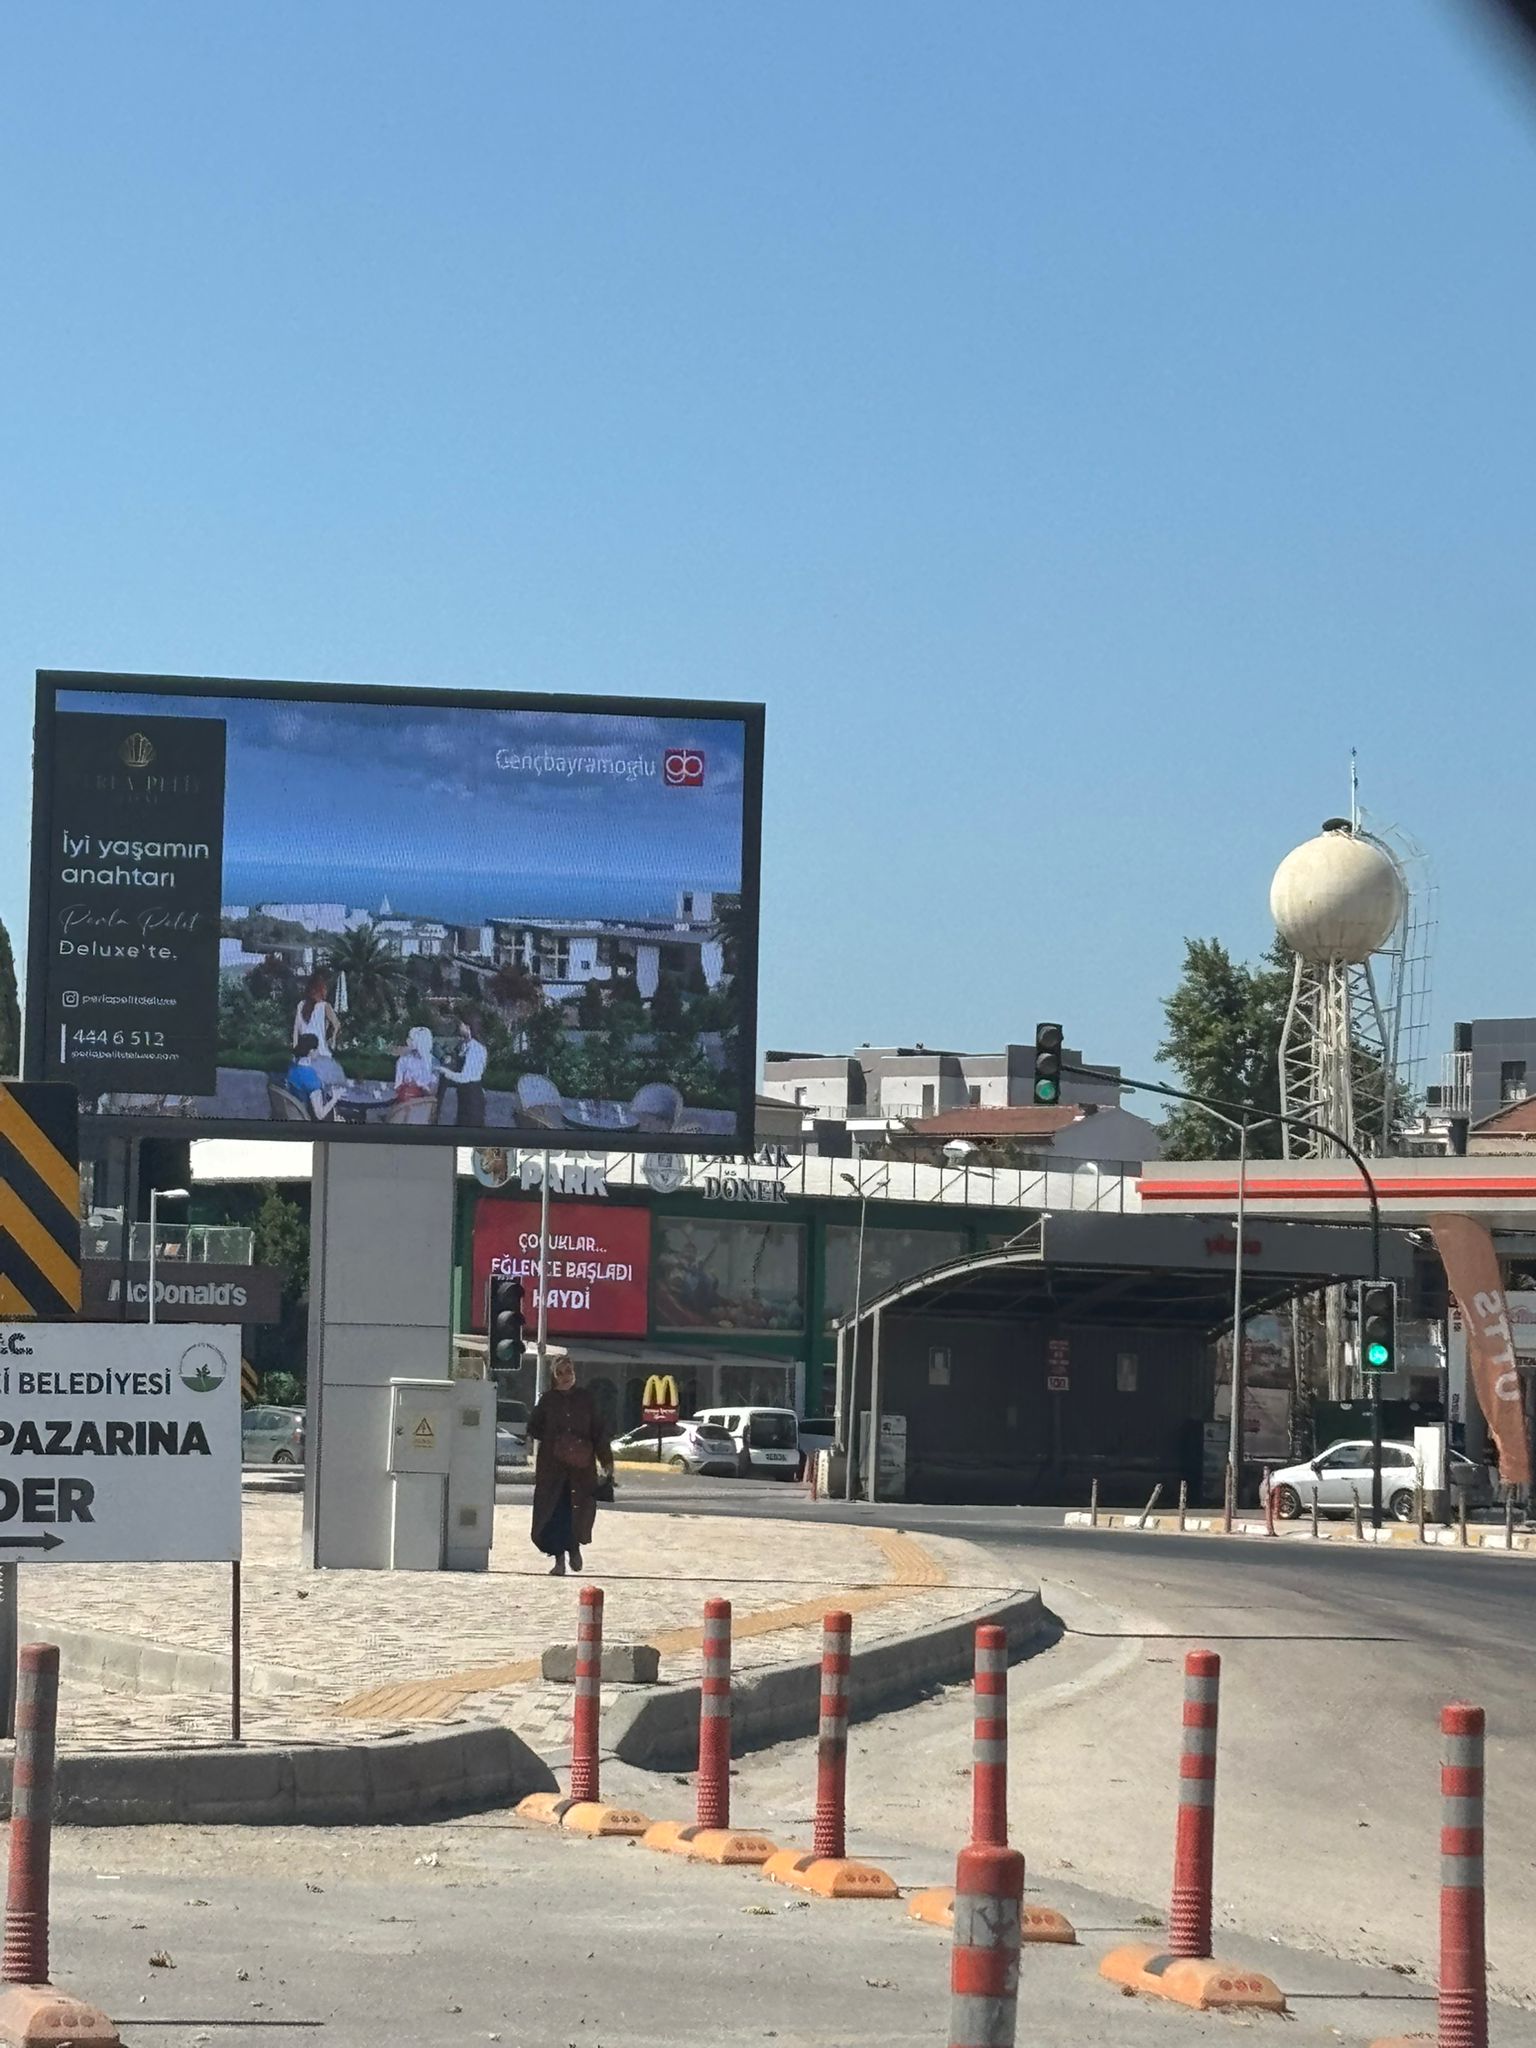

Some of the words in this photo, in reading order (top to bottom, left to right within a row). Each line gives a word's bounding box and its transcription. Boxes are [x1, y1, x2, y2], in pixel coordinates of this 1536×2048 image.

[63, 829, 91, 858] İyi
[98, 839, 210, 861] yaşamın
[61, 865, 175, 887] anahtarı
[59, 940, 178, 960] Deluxe'te.
[73, 1029, 107, 1045] 444
[113, 1030, 124, 1045] 6
[131, 1031, 165, 1047] 512
[520, 1161, 609, 1197] PARK
[518, 1233, 608, 1253] ÇOUKLAR...
[566, 1261, 633, 1284] BAŞLADI
[107, 1279, 248, 1307] McDonald's
[18, 1368, 172, 1395] BELEDİYESİ
